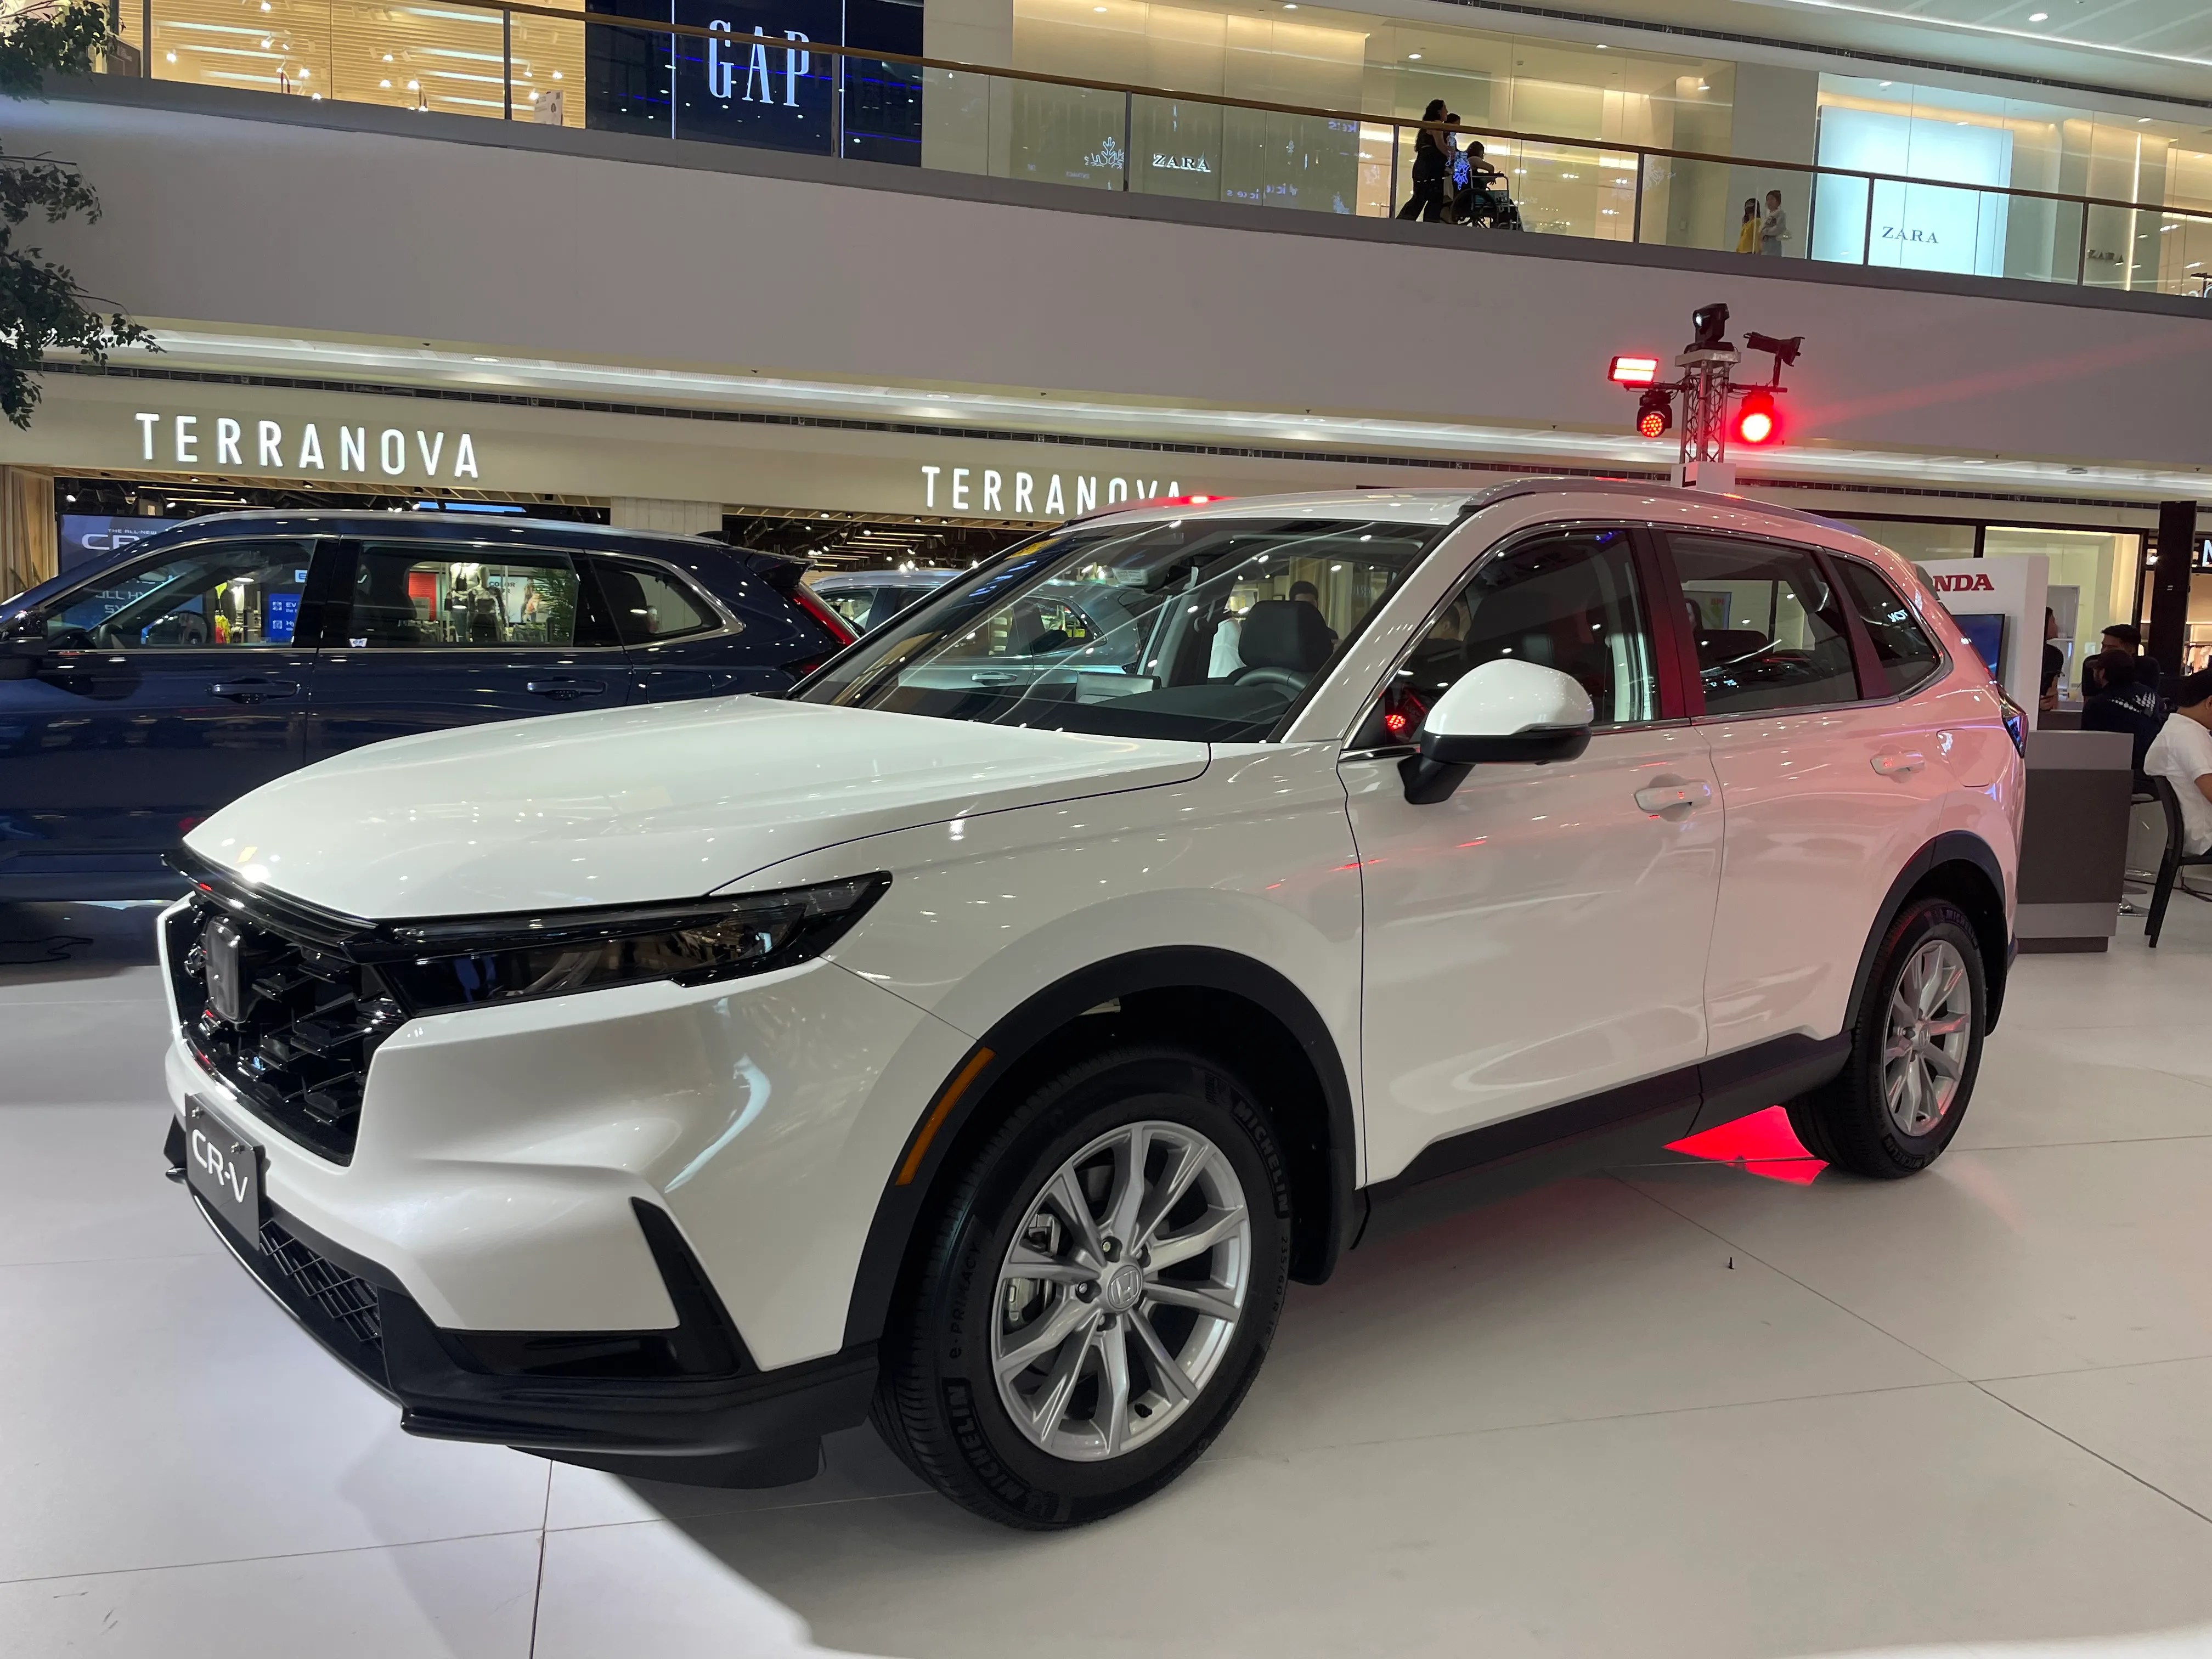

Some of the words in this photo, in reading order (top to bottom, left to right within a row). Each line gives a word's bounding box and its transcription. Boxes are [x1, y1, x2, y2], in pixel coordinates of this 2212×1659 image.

[709, 20, 809, 107] GAP
[1152, 153, 1211, 173] ZARA
[1882, 226, 1939, 244] ZARA
[2087, 249, 2124, 263] ZARA
[136, 413, 479, 479] TERRANOVA
[193, 1128, 248, 1203] CR-V
[1233, 1099, 1288, 1212] MICHELIN
[947, 1385, 1026, 1501] MICHELIN
